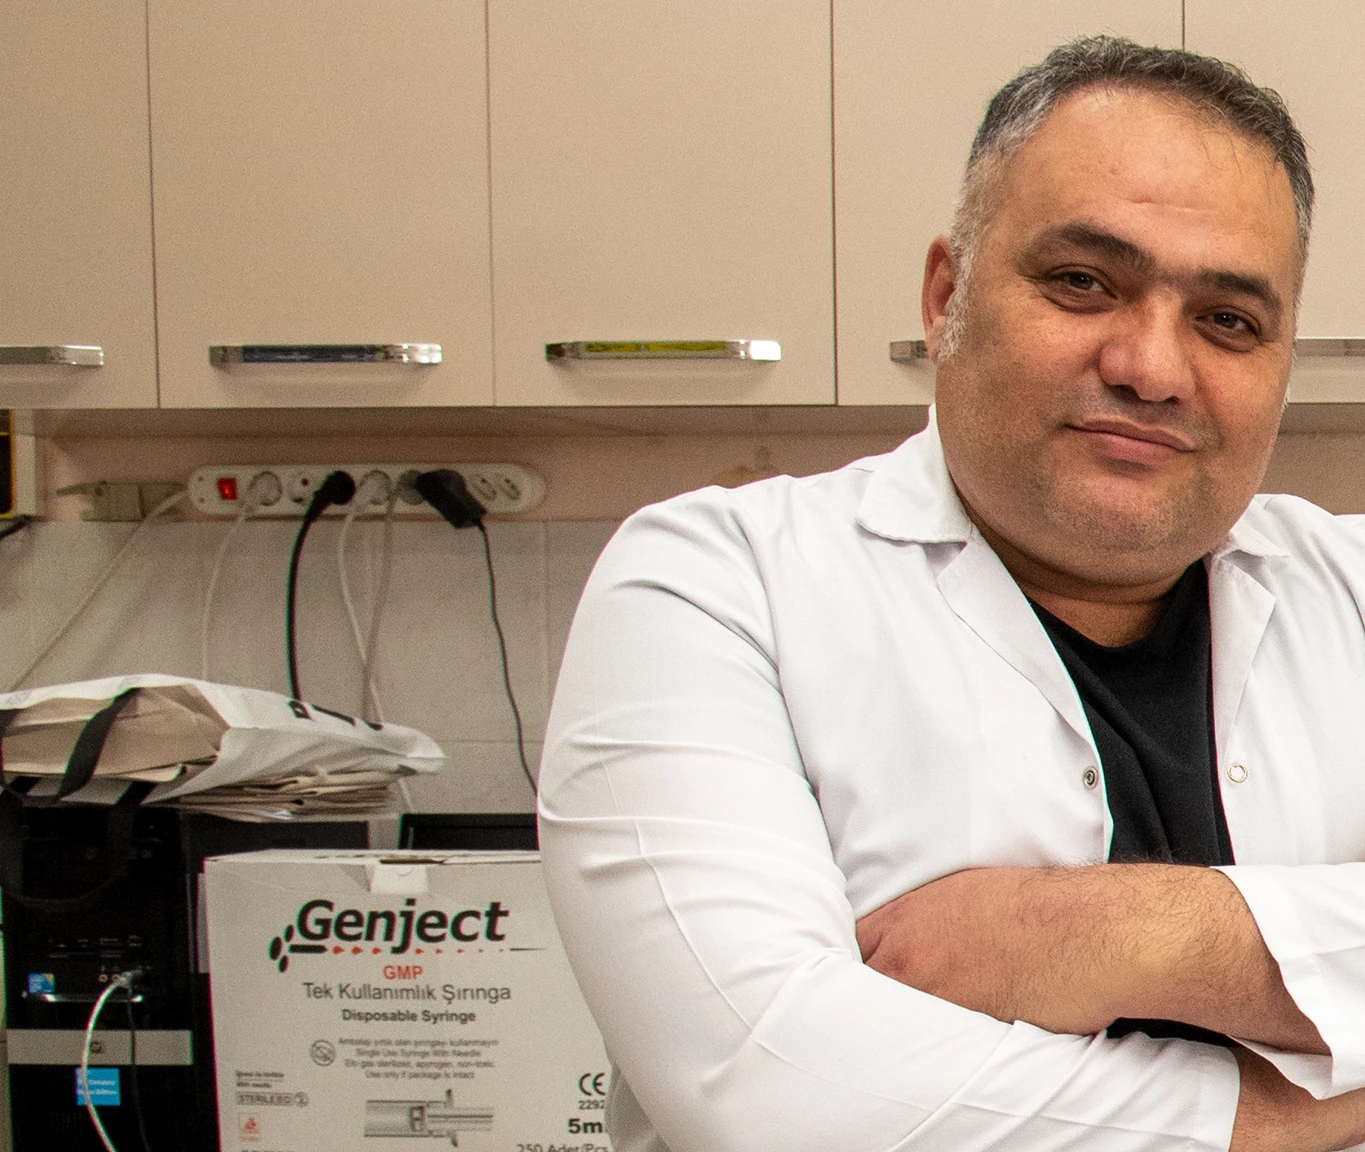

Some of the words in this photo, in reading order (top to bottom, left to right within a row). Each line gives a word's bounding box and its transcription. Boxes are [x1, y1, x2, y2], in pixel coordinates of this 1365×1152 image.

[296, 898, 511, 955] Genject
[382, 965, 424, 980] GMP
[303, 982, 333, 1000] Tek
[338, 983, 437, 1001] Kullanımlık
[441, 984, 511, 1005] Şırınga
[342, 1009, 418, 1023] Disposable
[421, 1010, 477, 1024] Syringe
[578, 1072, 606, 1096] CE
[568, 1118, 603, 1134] 5m
